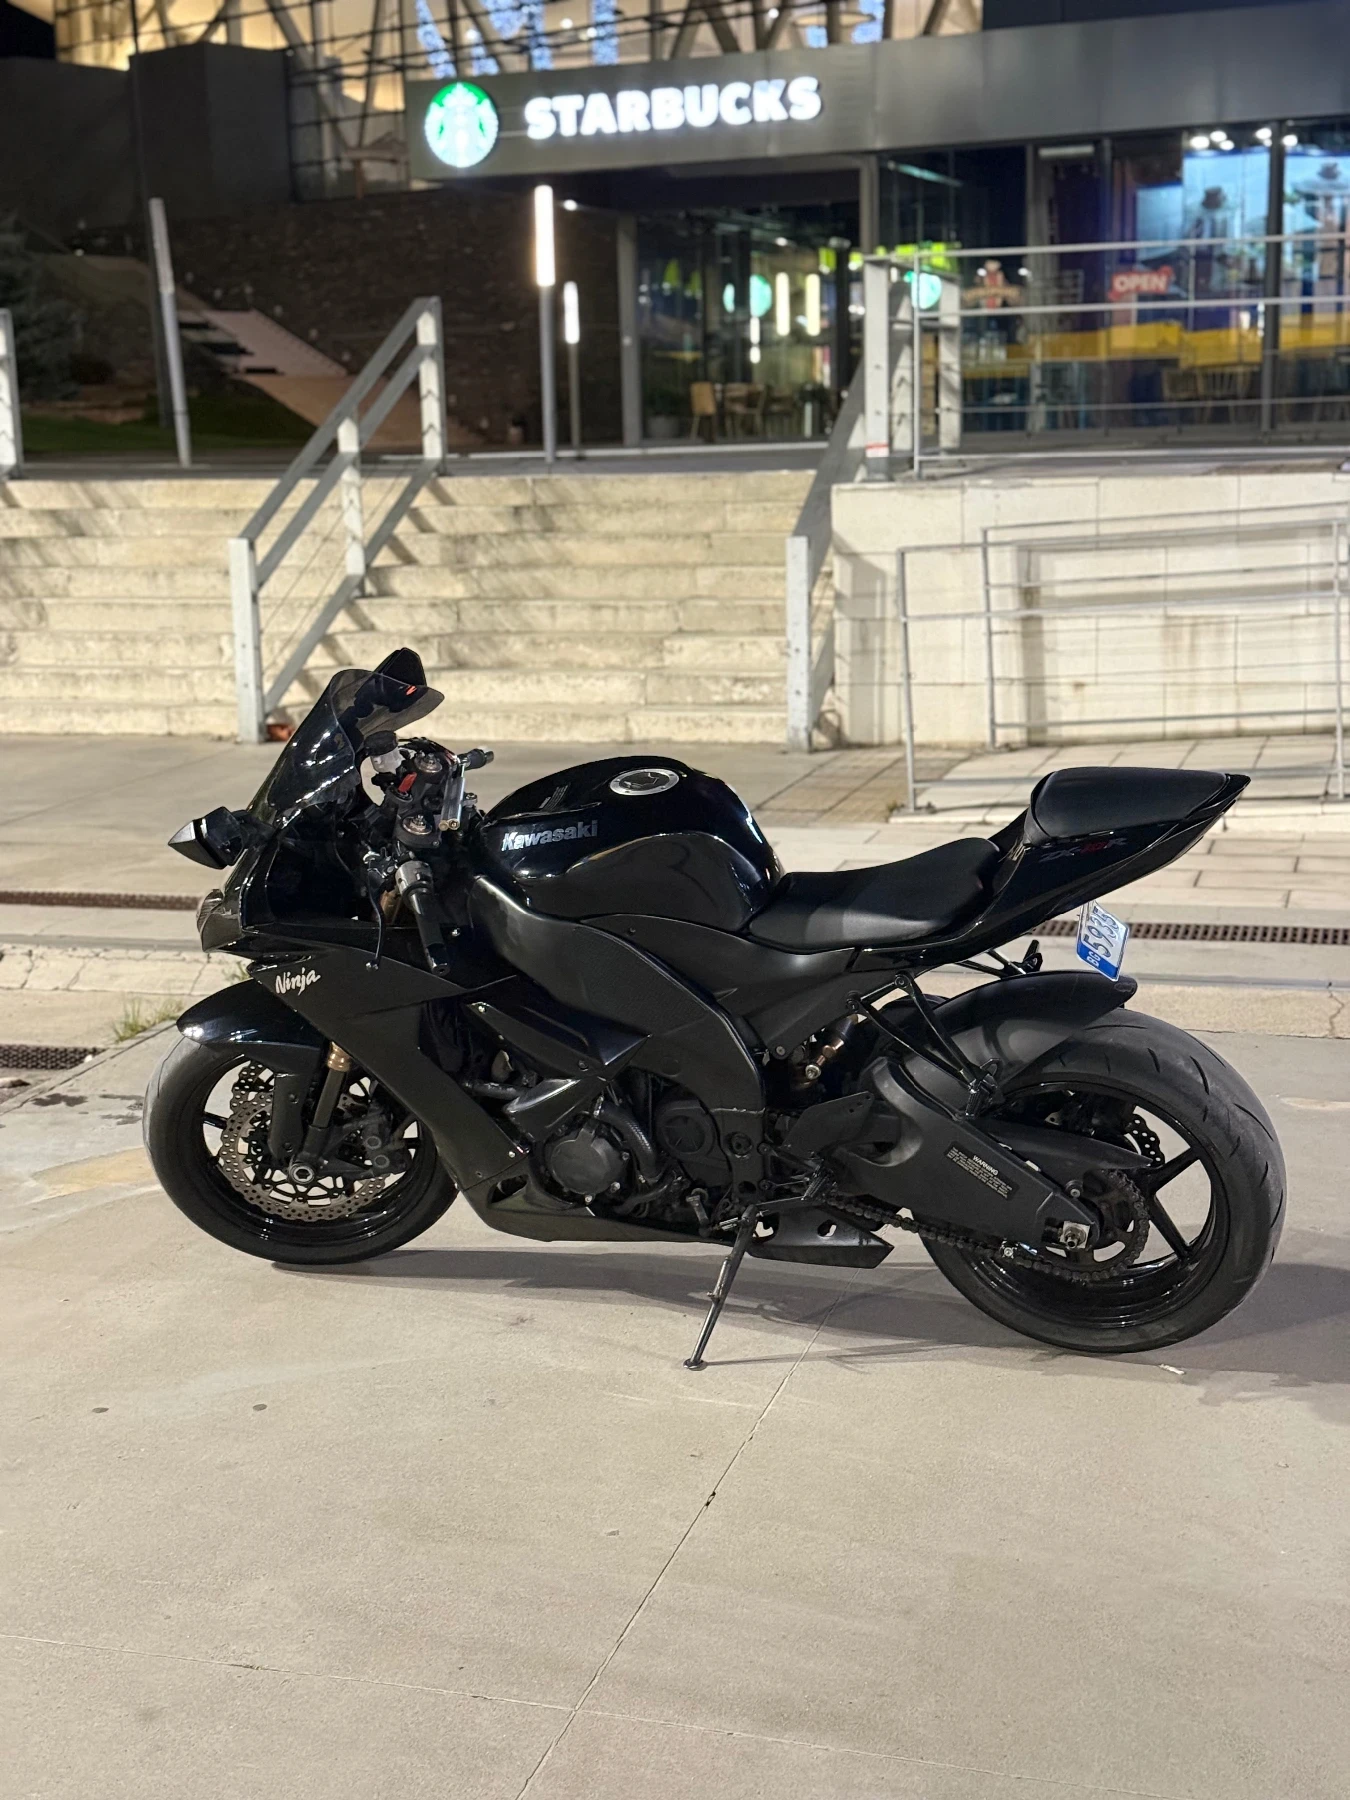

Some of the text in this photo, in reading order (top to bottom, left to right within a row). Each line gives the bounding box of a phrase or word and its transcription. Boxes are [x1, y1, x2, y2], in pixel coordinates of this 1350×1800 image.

[524, 76, 823, 140] STARBUCKS
[1113, 274, 1167, 293] OPEN
[501, 820, 599, 852] Kawasaki
[1086, 950, 1101, 968] BG
[275, 966, 321, 996] Ninja
[972, 1154, 999, 1176] WARNING
